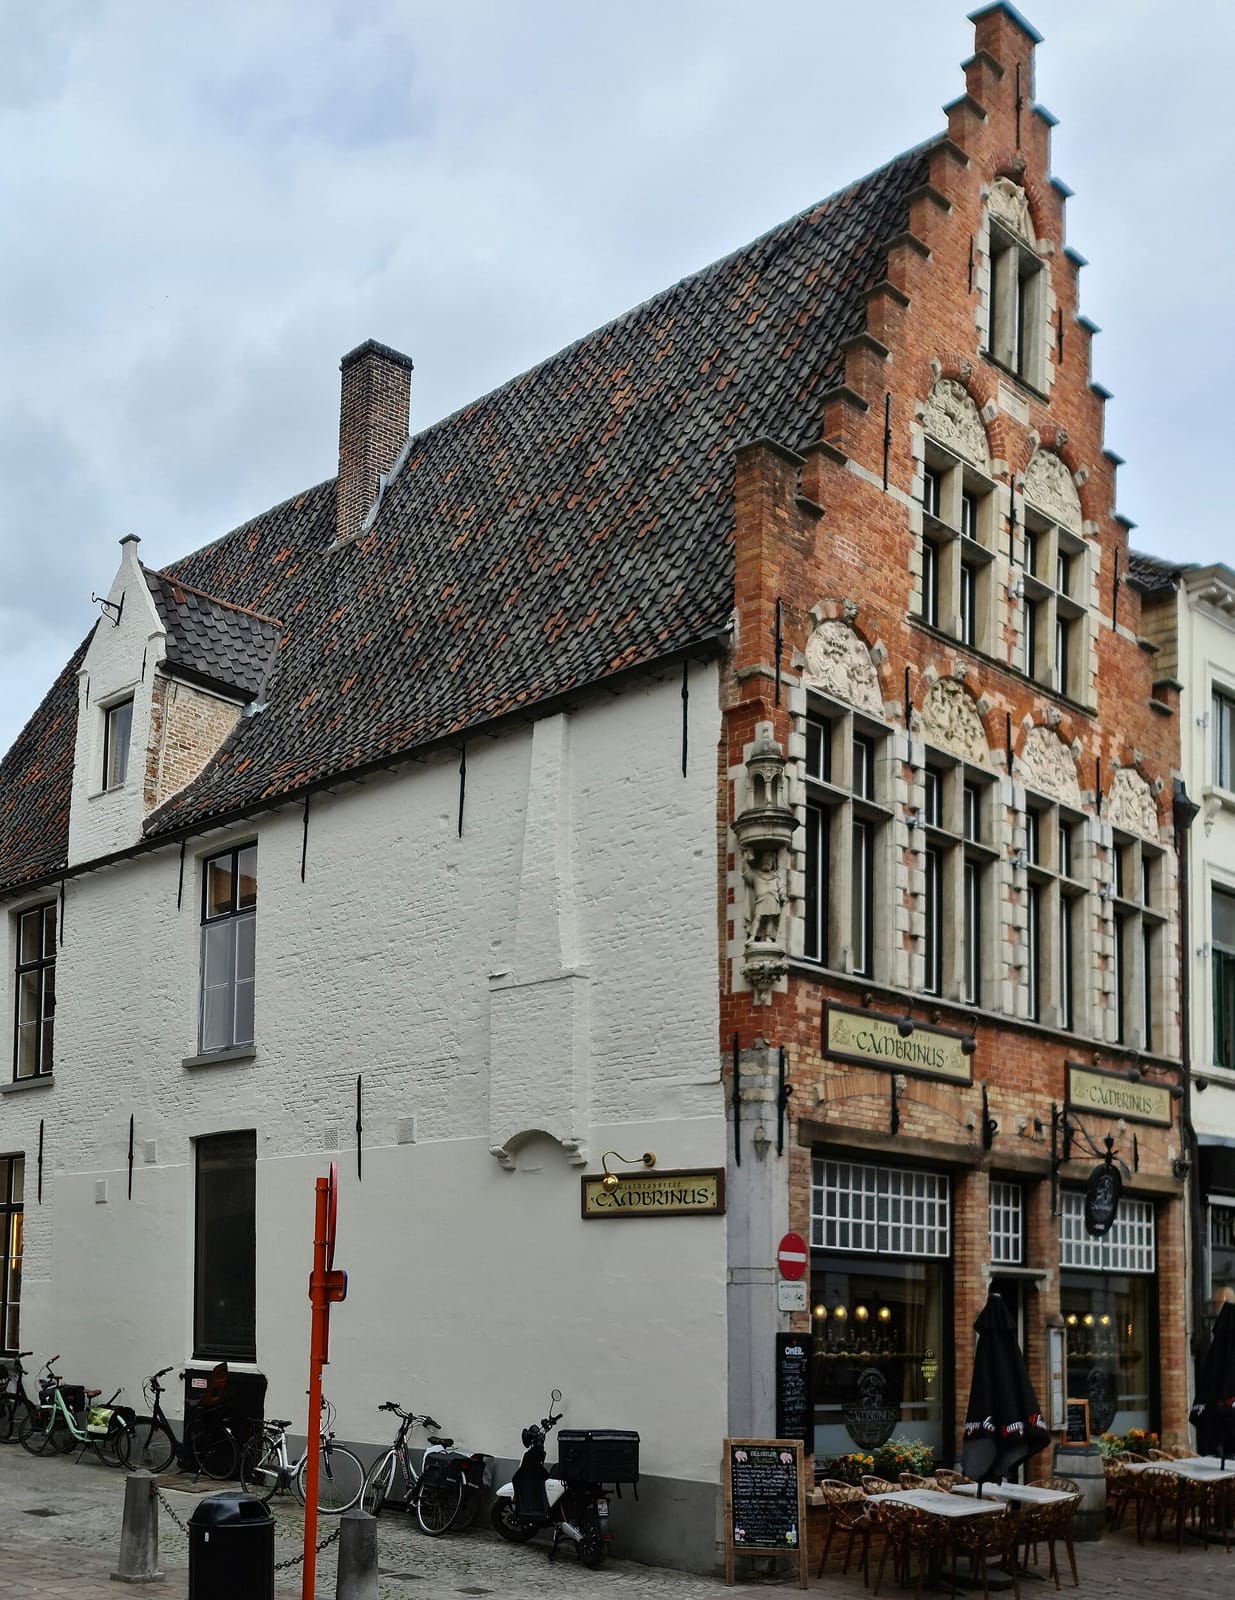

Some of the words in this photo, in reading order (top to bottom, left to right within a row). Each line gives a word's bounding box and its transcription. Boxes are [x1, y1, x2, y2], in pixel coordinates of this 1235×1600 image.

[856, 1031, 945, 1067] CAMBRINUS
[1089, 1086, 1152, 1113] CAMBRINUS
[595, 1188, 709, 1207] CAMBRINUS
